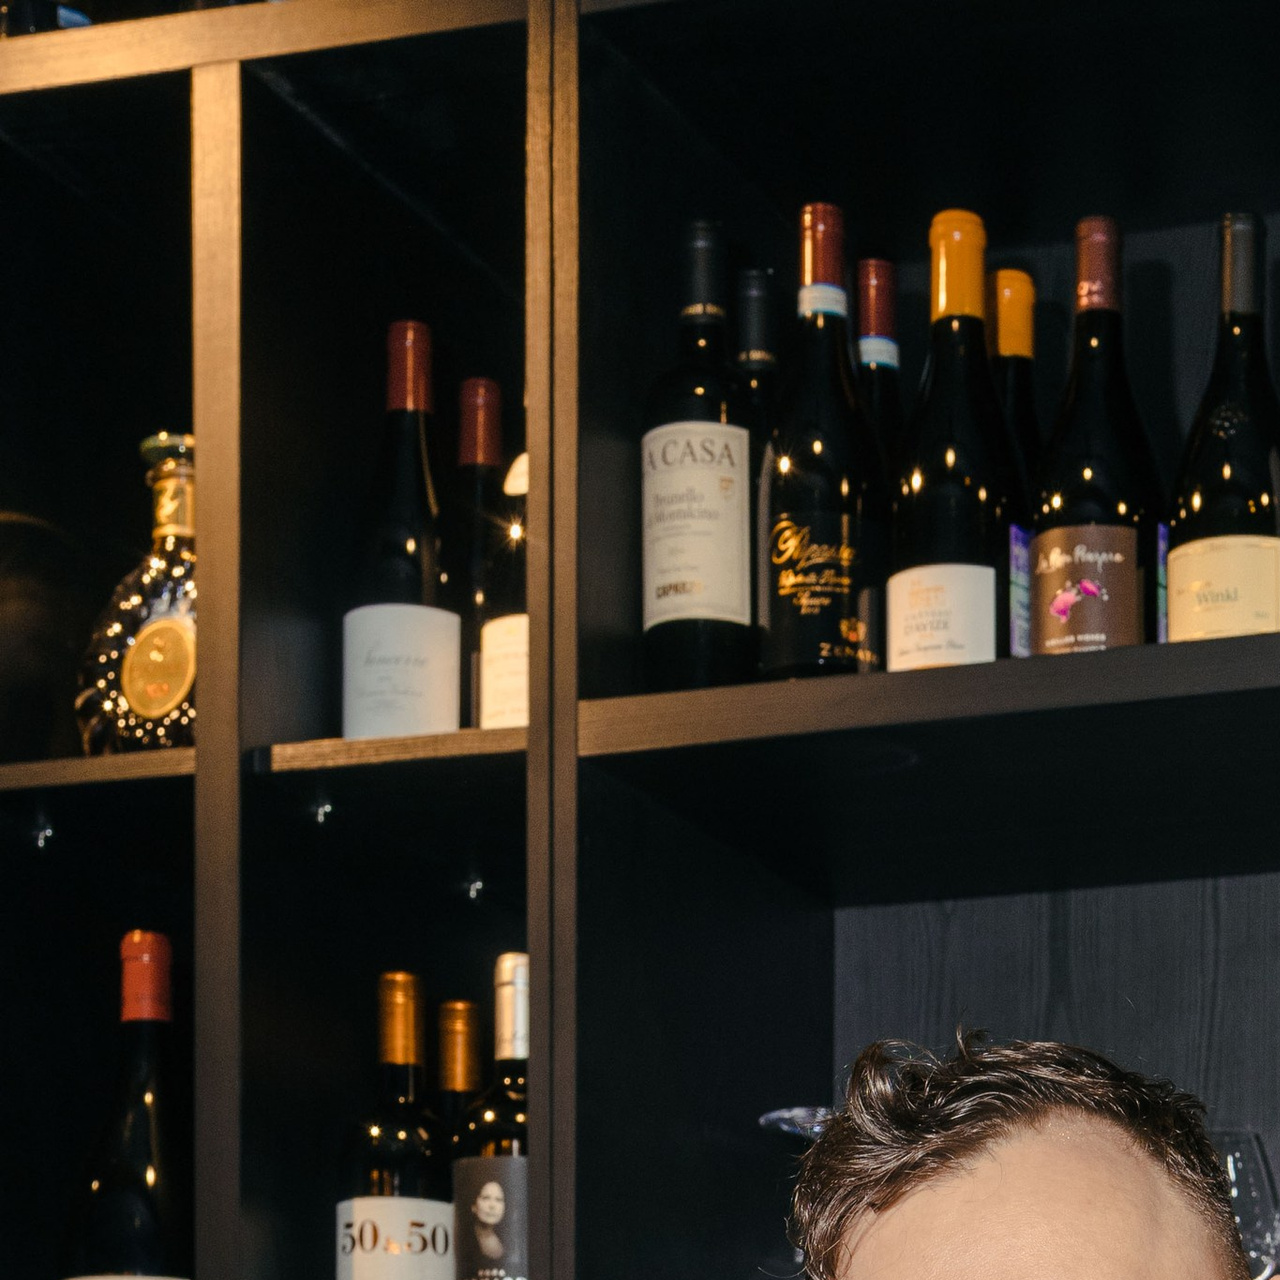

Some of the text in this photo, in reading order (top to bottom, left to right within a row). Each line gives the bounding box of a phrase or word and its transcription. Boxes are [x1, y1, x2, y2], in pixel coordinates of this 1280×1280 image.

[661, 437, 736, 469] CASA
[341, 1220, 381, 1256] 50
[407, 1219, 450, 1256] 50
